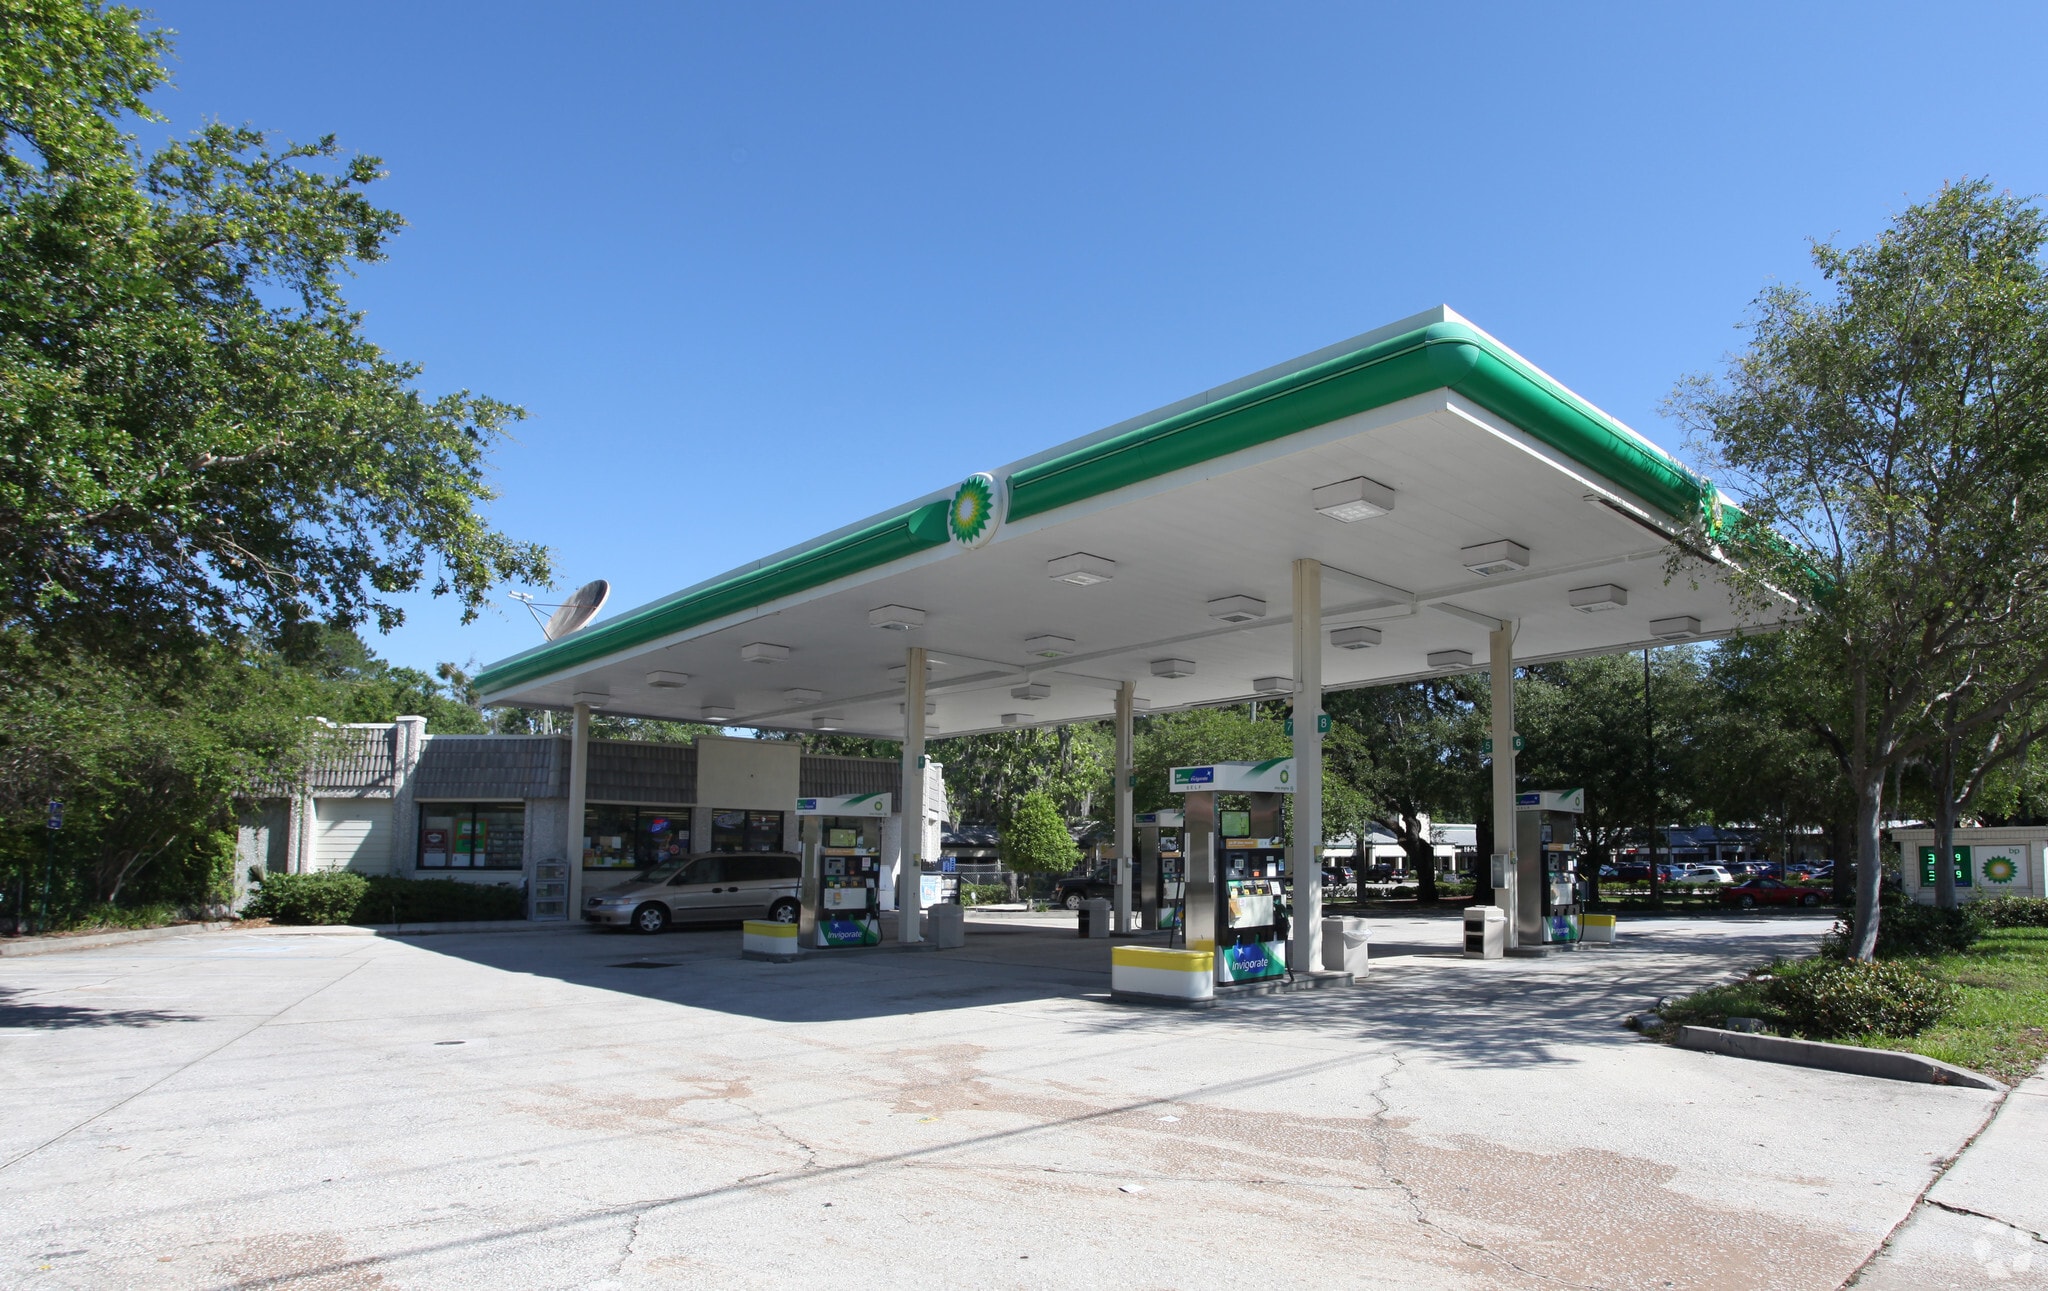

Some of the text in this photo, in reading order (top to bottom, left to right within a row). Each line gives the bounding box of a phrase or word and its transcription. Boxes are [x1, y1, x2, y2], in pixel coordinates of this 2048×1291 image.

[1287, 721, 1293, 731] 7
[1320, 717, 1328, 729] 8
[1485, 741, 1491, 750] 5
[1515, 738, 1522, 747] 6
[2008, 847, 2020, 855] bp
[827, 930, 863, 941] Invigorate
[1231, 957, 1269, 972] Invigorate
